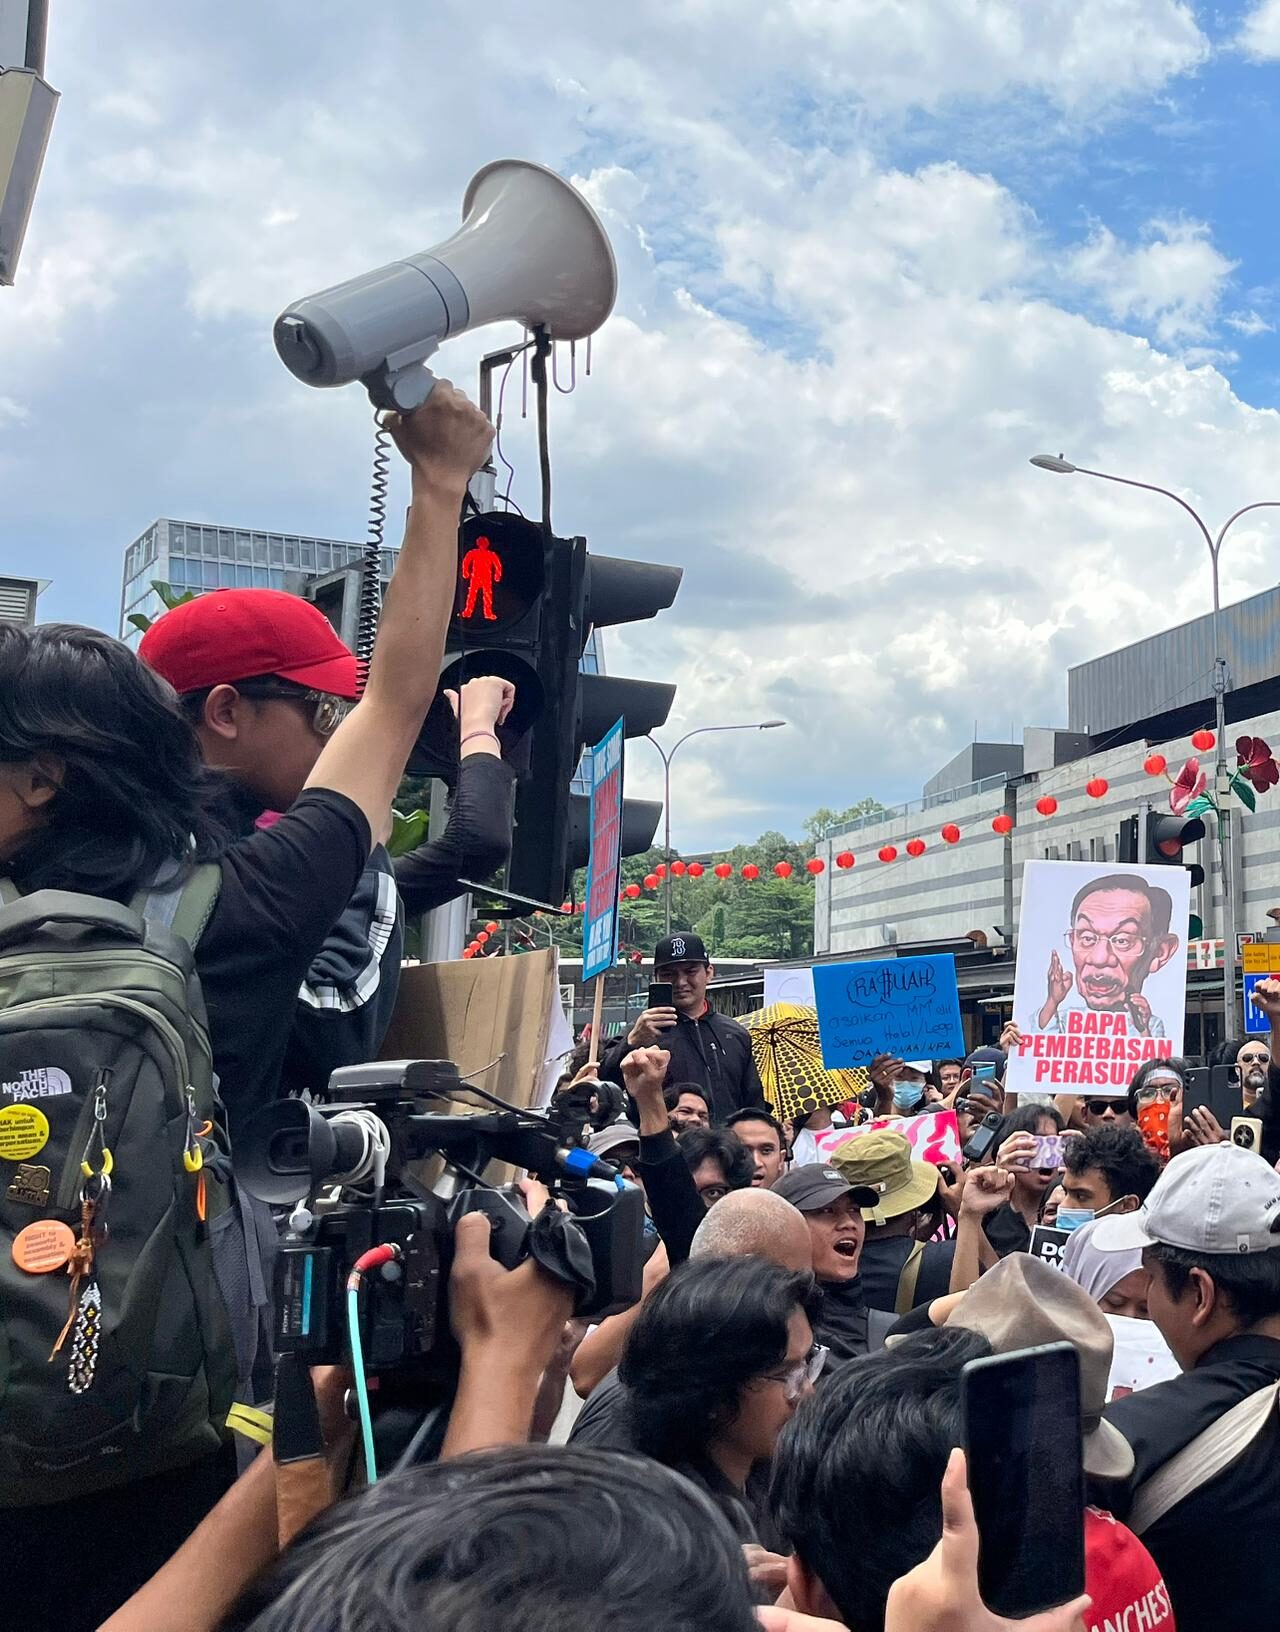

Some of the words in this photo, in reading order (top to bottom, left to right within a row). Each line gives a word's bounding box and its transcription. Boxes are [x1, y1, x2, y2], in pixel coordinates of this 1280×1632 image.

[1068, 1012, 1127, 1036] BAPA
[1018, 1035, 1172, 1061] PEMBEBASAN
[19, 1068, 47, 1081] THE
[2, 1079, 48, 1094] NORTH
[13, 1089, 48, 1102] FACE
